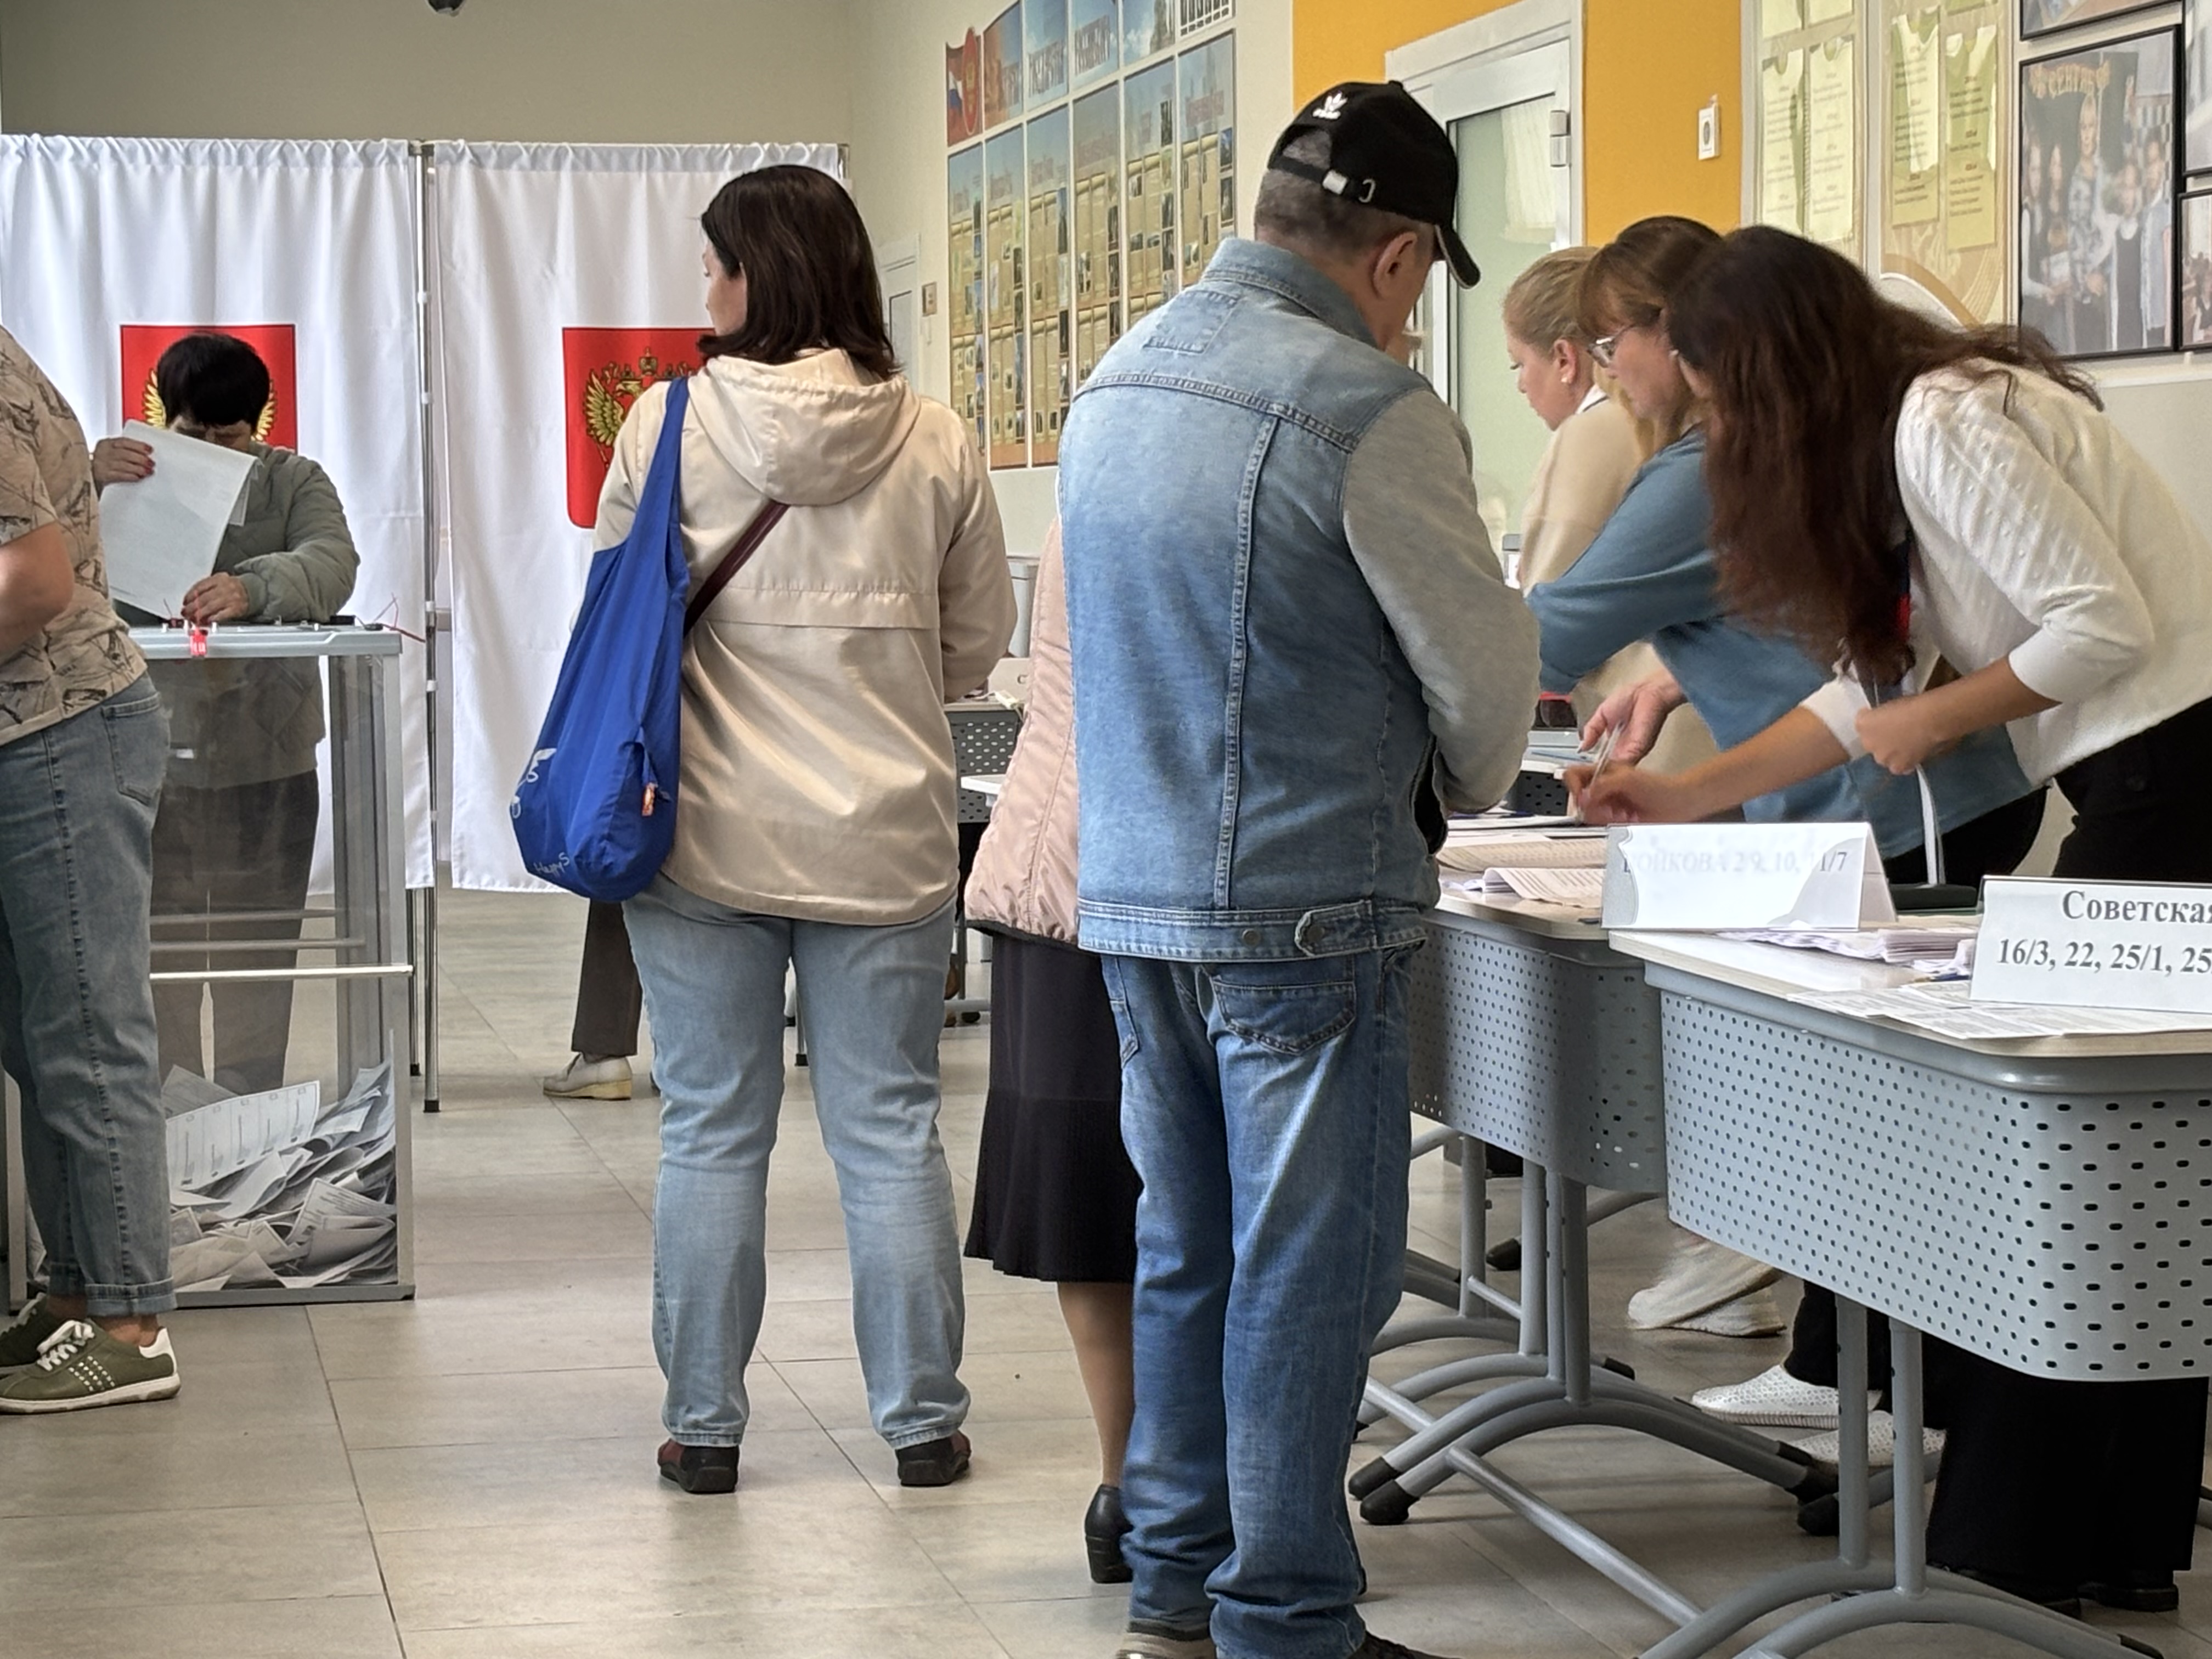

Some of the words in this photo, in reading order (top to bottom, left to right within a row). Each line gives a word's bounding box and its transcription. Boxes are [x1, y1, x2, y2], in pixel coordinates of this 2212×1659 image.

[1997, 938, 2056, 971] 16/3,
[2064, 941, 2101, 974] 22,
[2109, 944, 2172, 977] 25/1,
[2180, 946, 2212, 974] 25
